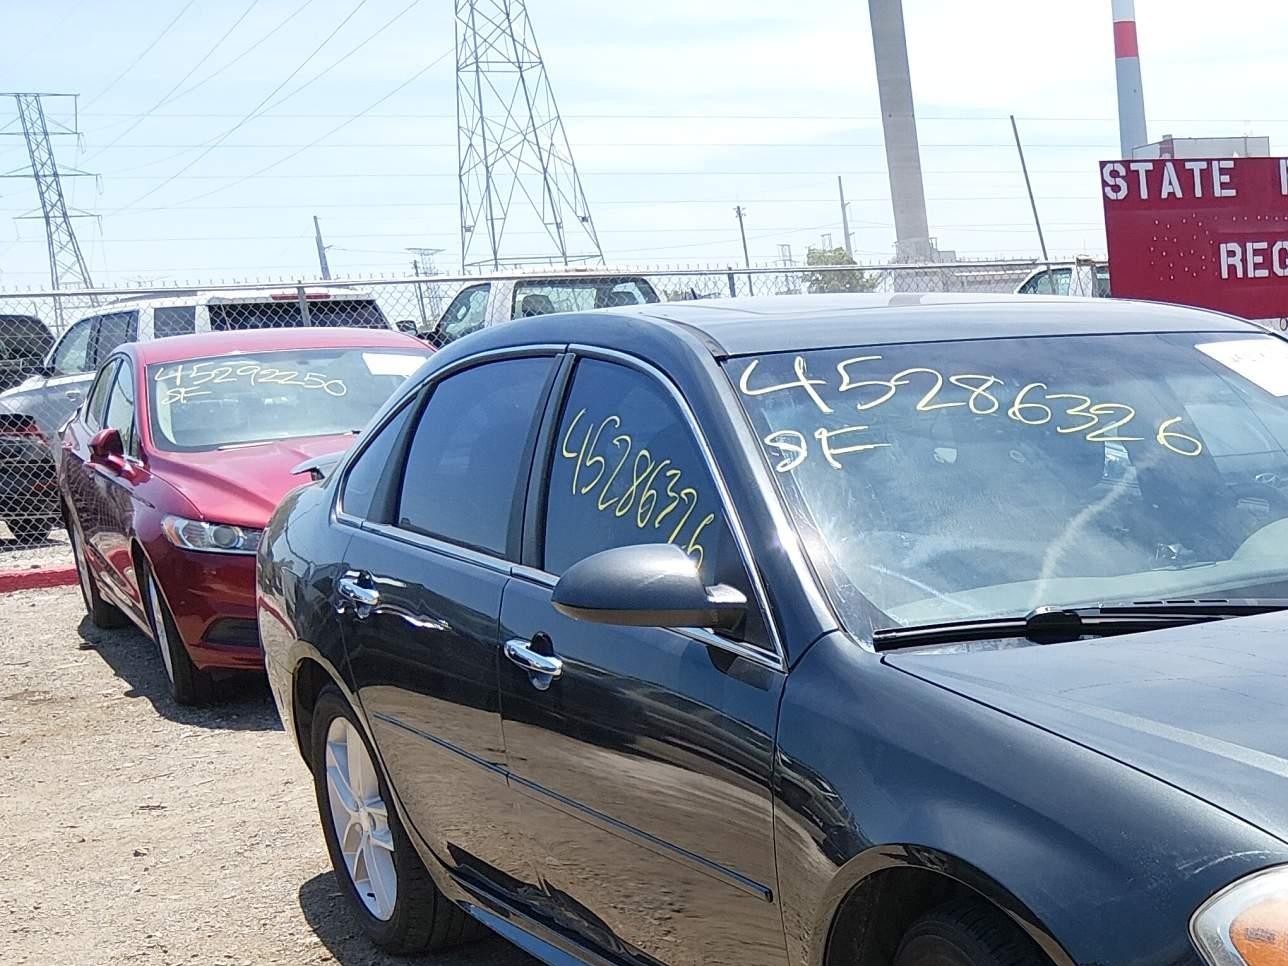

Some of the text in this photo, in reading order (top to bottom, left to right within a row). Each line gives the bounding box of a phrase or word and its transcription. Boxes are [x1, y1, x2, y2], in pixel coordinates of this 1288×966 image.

[1102, 160, 1237, 200] STATE
[154, 361, 347, 397] 45292250
[161, 385, 212, 405] SF
[739, 355, 1202, 457] 45286326
[763, 425, 894, 473] SF
